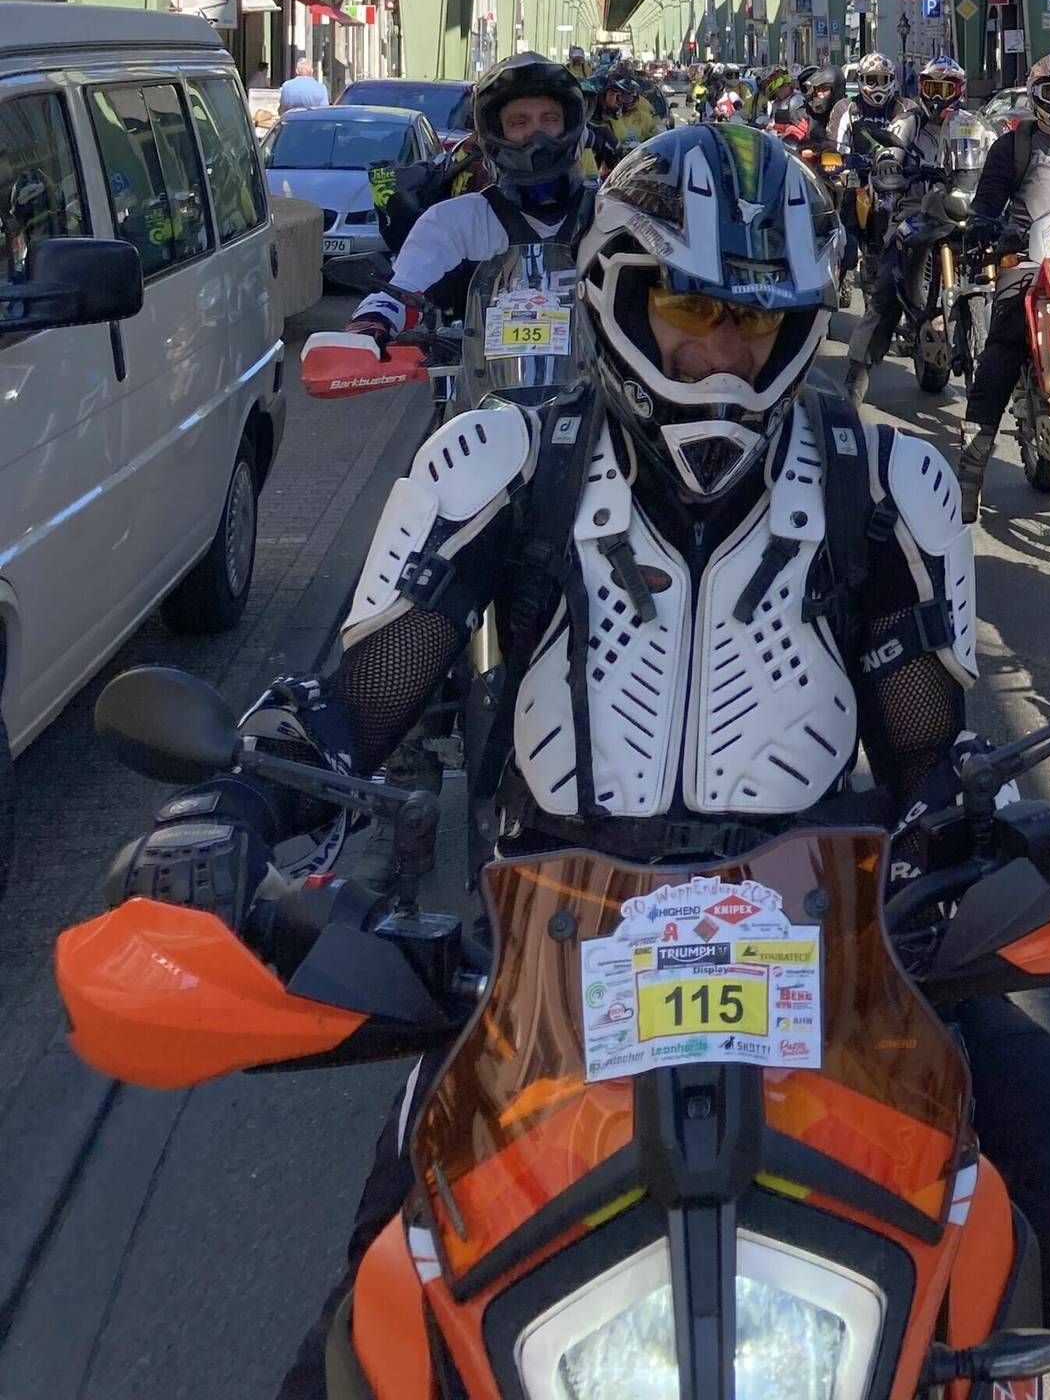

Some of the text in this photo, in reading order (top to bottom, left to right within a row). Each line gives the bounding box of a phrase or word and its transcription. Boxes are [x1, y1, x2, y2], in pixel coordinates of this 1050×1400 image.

[927, 0, 937, 15] P
[511, 327, 543, 342] 135
[330, 374, 408, 390] Barkbusters
[713, 904, 753, 915] KNIPEX
[659, 945, 716, 961] TRIUMPH
[693, 965, 729, 976] Display
[664, 984, 745, 1027] 115
